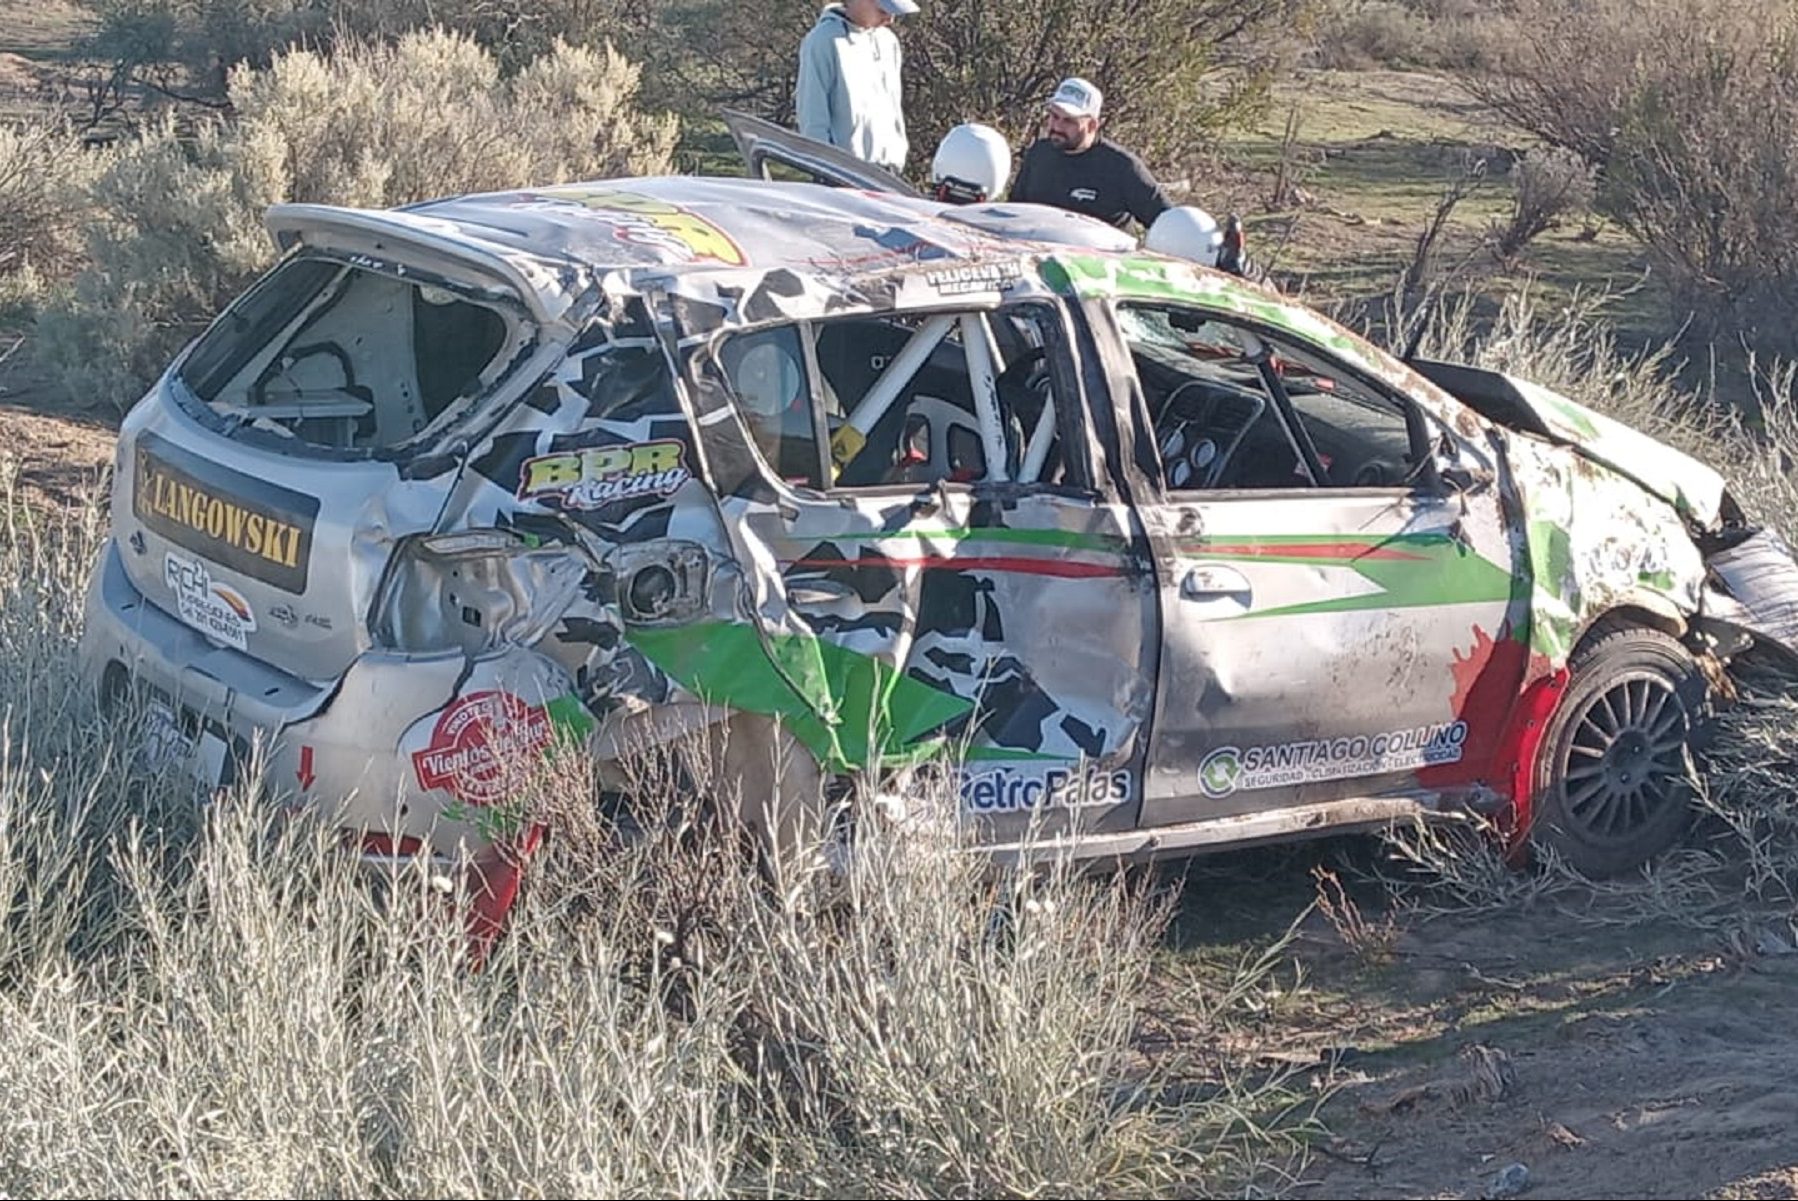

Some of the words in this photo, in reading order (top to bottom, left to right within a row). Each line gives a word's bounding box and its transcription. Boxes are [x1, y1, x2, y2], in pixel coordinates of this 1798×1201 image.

[527, 444, 682, 492] BPR
[563, 467, 688, 504] Racing
[154, 473, 301, 568] LANGOWSKI
[1244, 739, 1366, 771] SANTIAGO
[1372, 724, 1465, 756] COLLINO
[1244, 770, 1304, 788] SEGURIDAD
